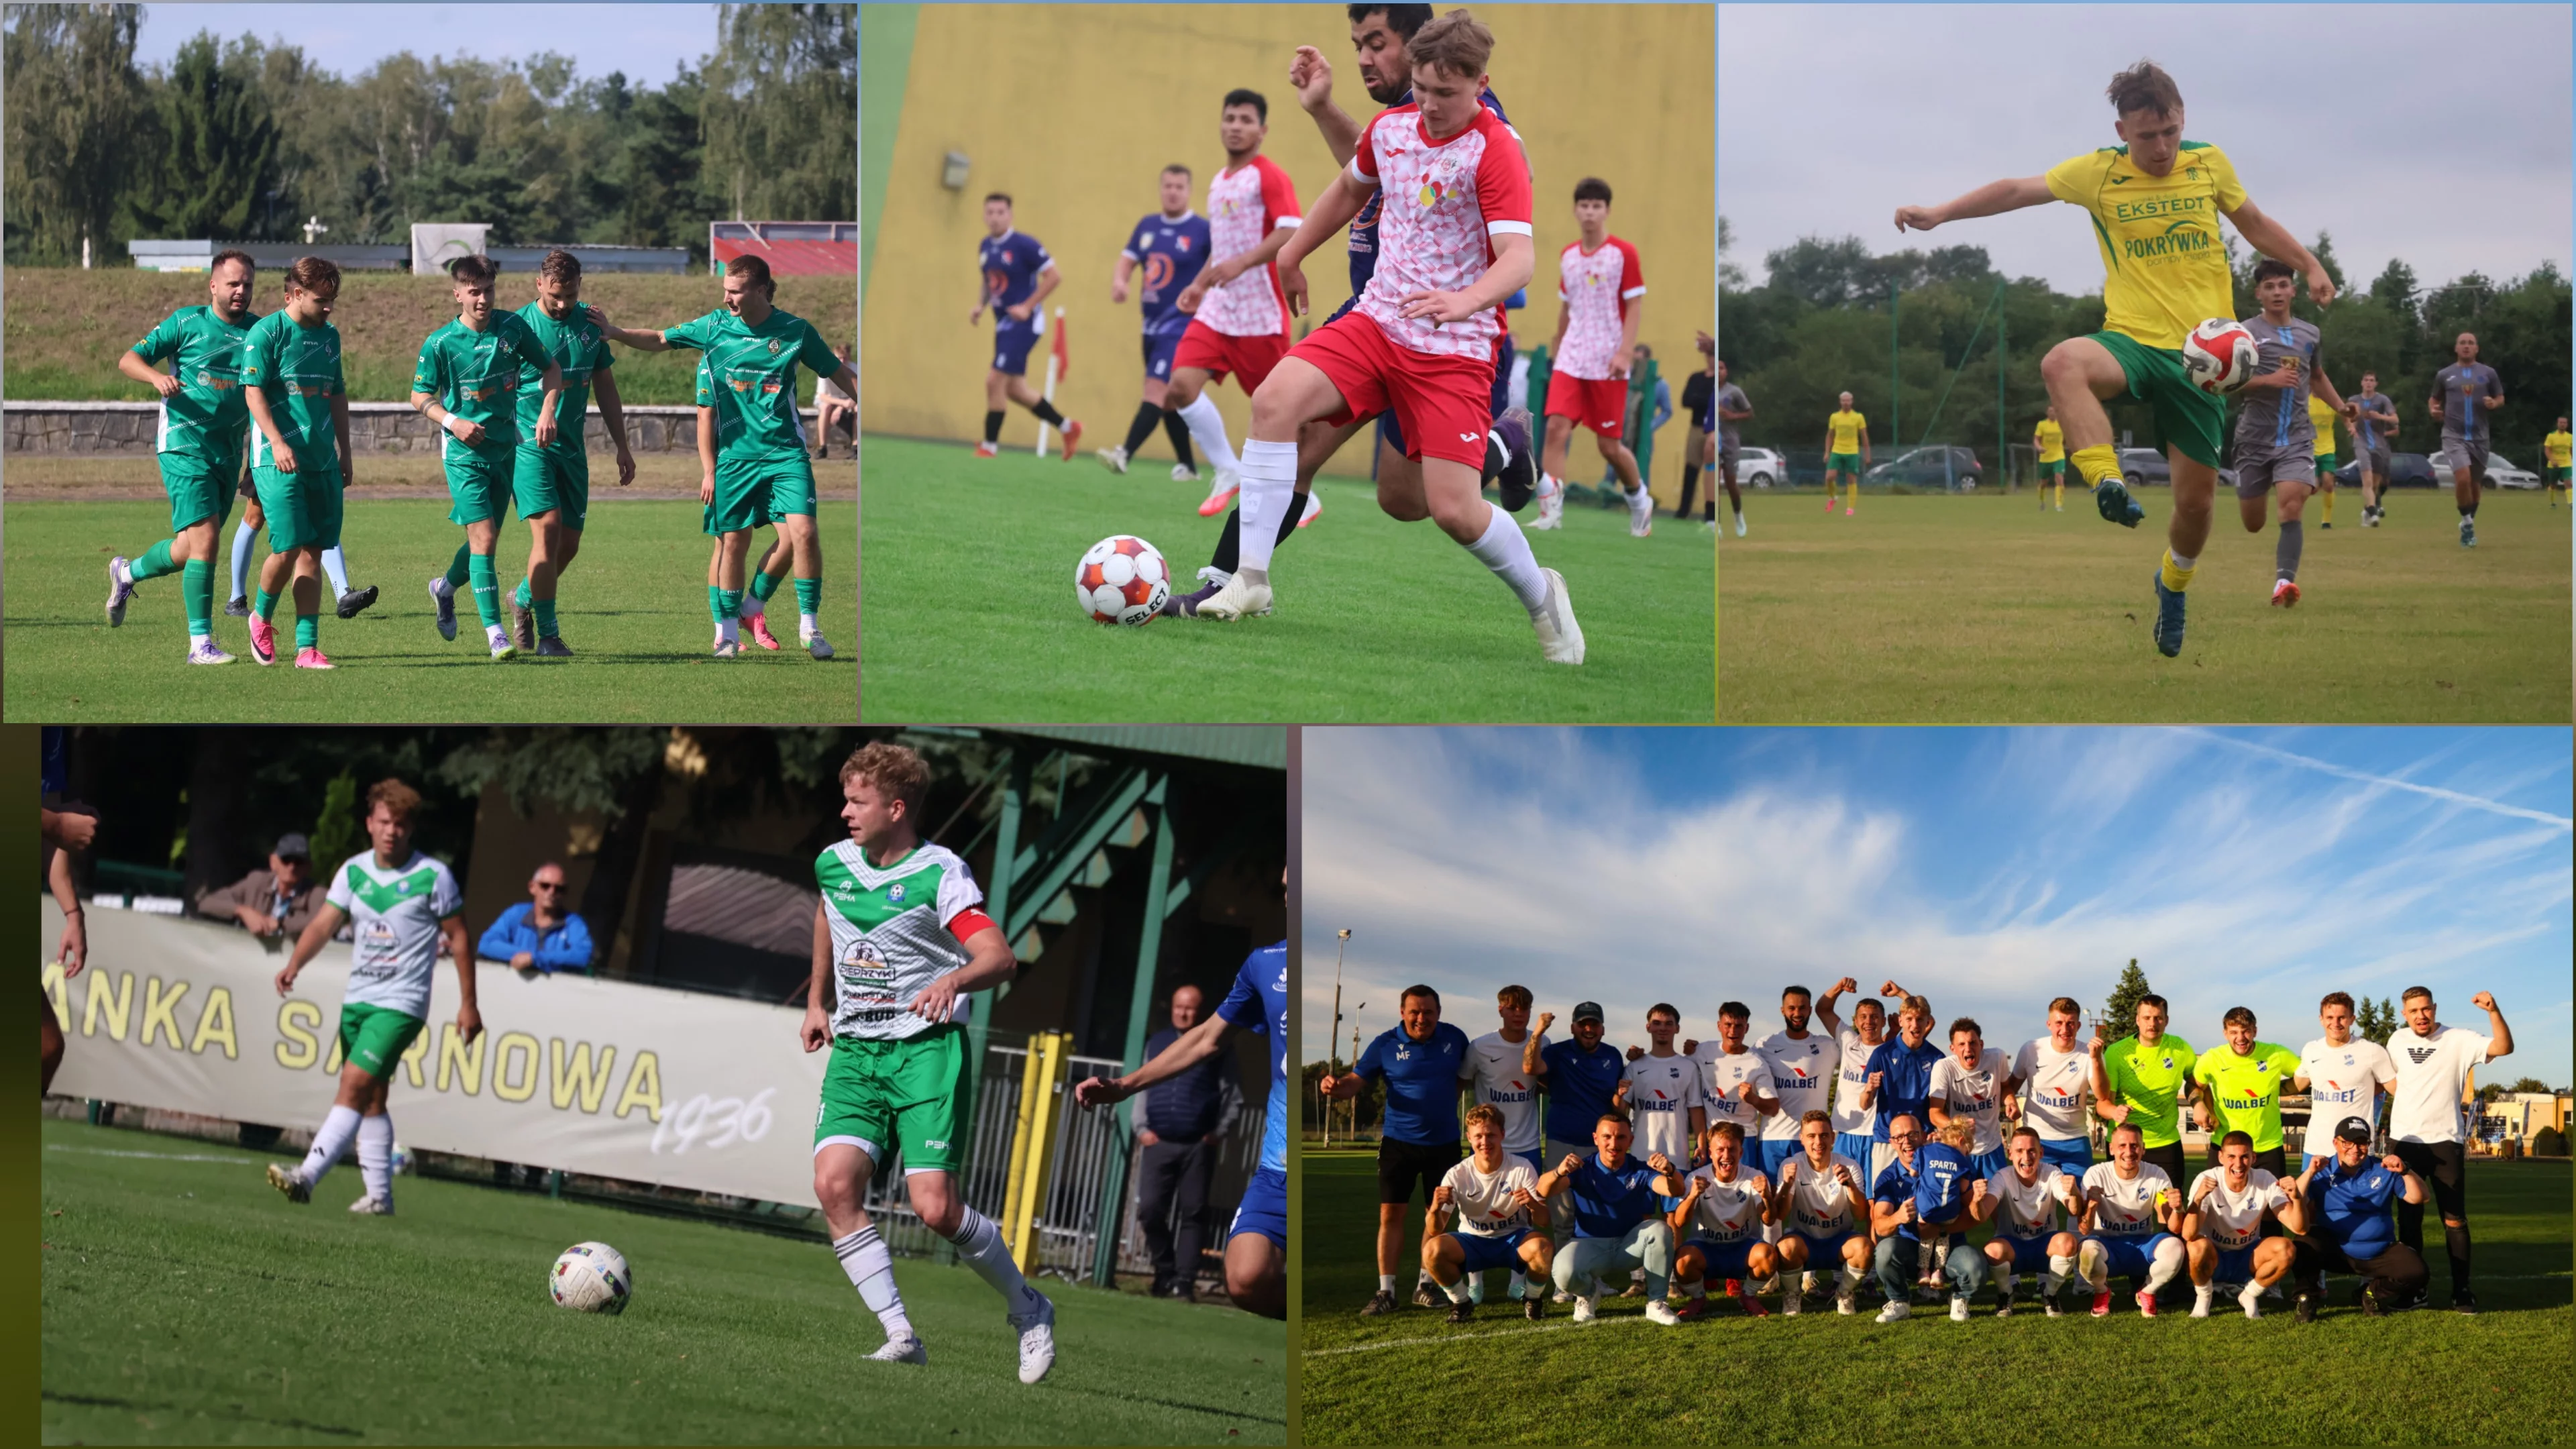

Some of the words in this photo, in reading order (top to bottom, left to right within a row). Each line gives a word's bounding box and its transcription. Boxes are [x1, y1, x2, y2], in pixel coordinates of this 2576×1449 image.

[2116, 197, 2205, 219] EKSTEDT
[2125, 231, 2210, 259] POKRYWKA
[474, 585, 497, 594] zina
[1125, 587, 1167, 626] SELECT
[833, 892, 856, 902] PEHA
[1396, 1051, 1411, 1061] MF
[274, 999, 662, 1124] SRNOWA
[651, 1087, 777, 1155] 1936
[1774, 1075, 1819, 1089] WALBET
[2036, 1091, 2081, 1108] WALBET
[2222, 1093, 2271, 1110] WALBET
[2312, 1088, 2357, 1103] WALBET
[1929, 1159, 1958, 1171] SPARTA
[1935, 1171, 1953, 1208] 7
[1797, 1209, 1844, 1229] WALBET
[2100, 1214, 2151, 1232] WALBET
[1703, 1218, 1750, 1241] WALBET
